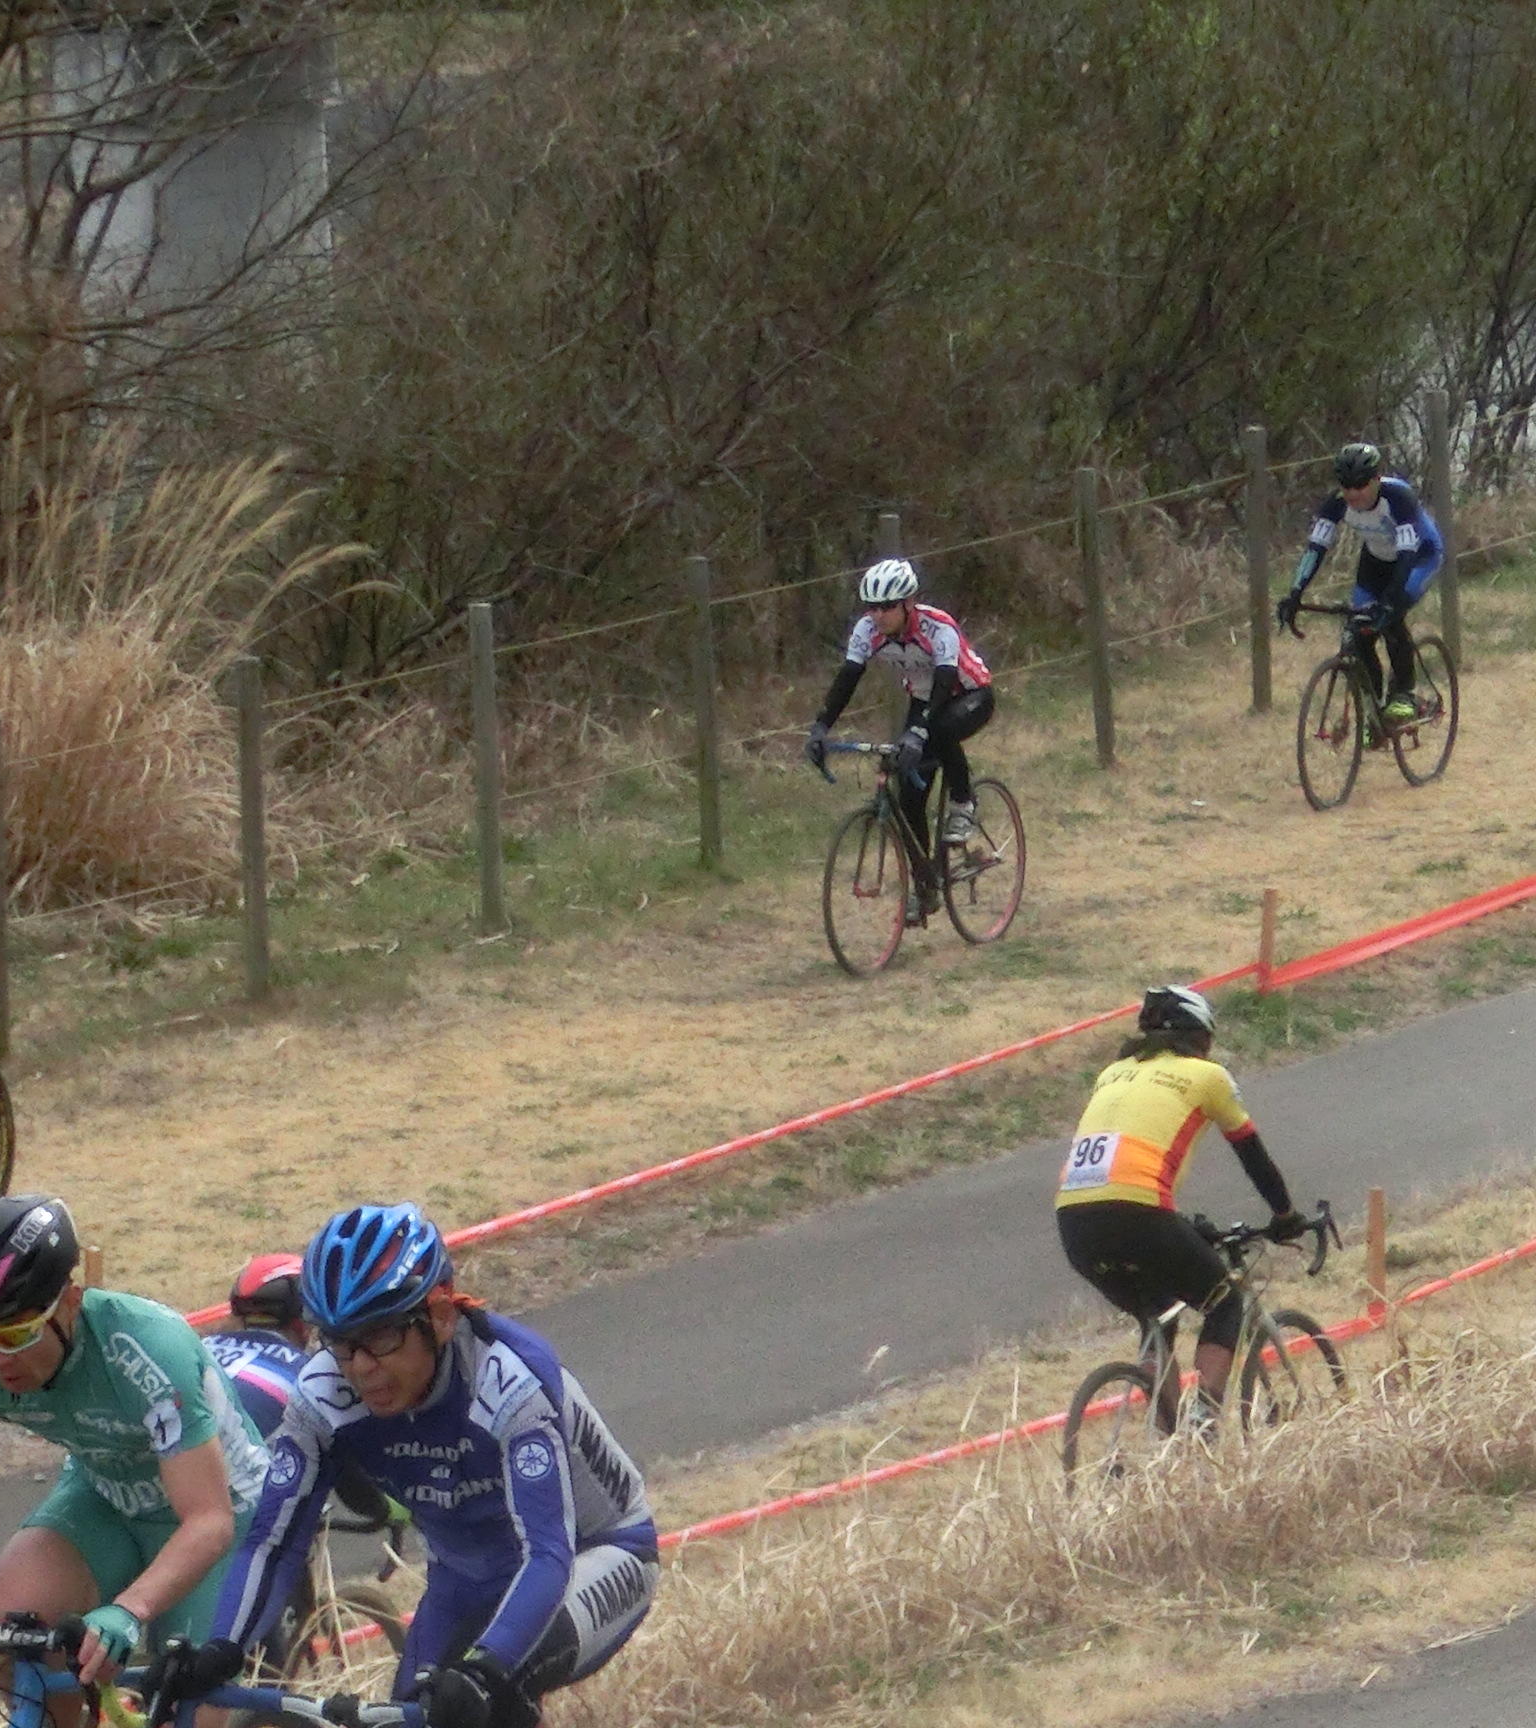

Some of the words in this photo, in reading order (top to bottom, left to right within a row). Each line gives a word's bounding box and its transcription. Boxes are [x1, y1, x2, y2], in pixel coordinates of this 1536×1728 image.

[1073, 1135, 1108, 1168] 96
[477, 1355, 518, 1416] 12
[571, 1400, 632, 1514] YAMAHA
[575, 1557, 646, 1632] YAMAHA
